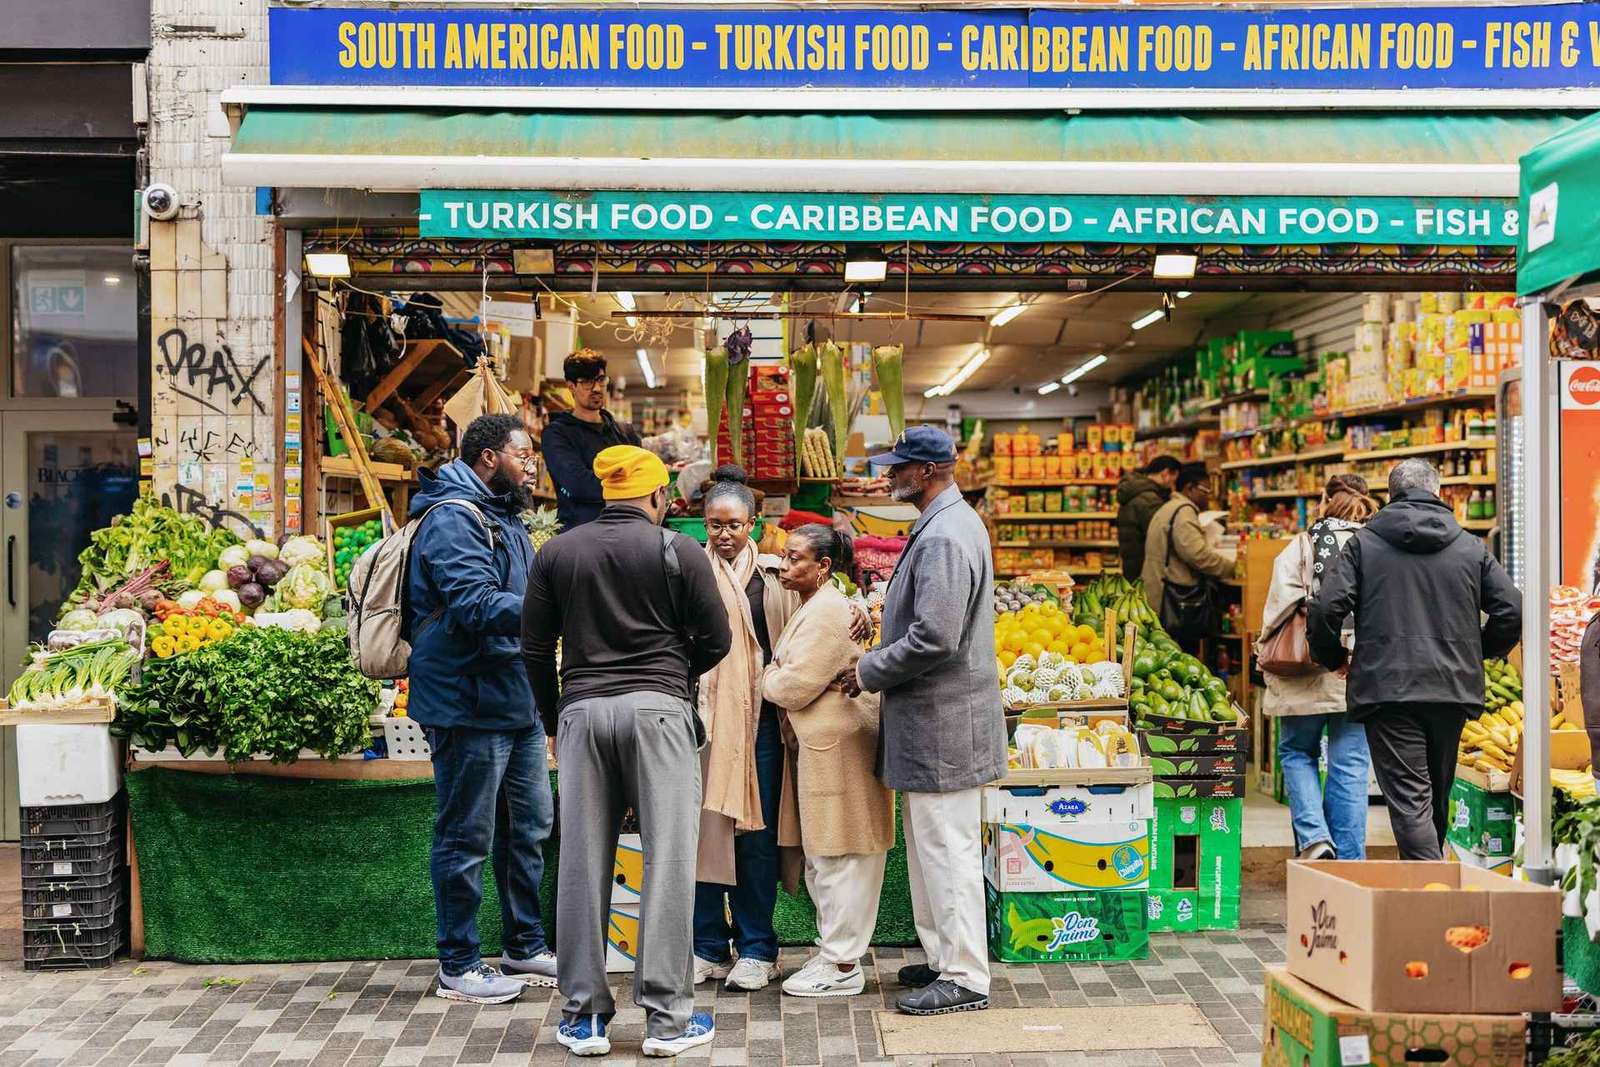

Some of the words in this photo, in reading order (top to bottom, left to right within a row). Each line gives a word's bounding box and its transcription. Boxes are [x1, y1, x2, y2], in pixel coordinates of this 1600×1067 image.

[338, 21, 436, 69] SOUTH
[443, 23, 600, 70] AMERICAN
[609, 23, 685, 70] FOOD
[691, 41, 707, 50] -
[714, 24, 846, 71] TURKISH
[854, 24, 930, 71] FOOD
[938, 42, 953, 50] -
[961, 24, 1129, 73] CARIBBEAN
[1138, 24, 1213, 72] FOOD
[1220, 42, 1236, 51] -
[1243, 23, 1371, 71] AFRICAN
[1379, 22, 1454, 70] FOOD
[1462, 39, 1477, 49] -
[1484, 21, 1552, 69] FISH
[1560, 20, 1581, 68] &
[443, 202, 598, 229] TURKISH
[611, 203, 713, 230] FOOD
[750, 204, 958, 232] CARIBBEAN
[971, 206, 1072, 233] FOOD
[1108, 207, 1266, 234] AFRICAN
[1279, 207, 1379, 234] FOOD
[1416, 208, 1490, 236] FISH
[1502, 209, 1519, 236] &
[157, 328, 270, 415] DRAX
[1064, 912, 1097, 930] Don
[1317, 899, 1336, 930] Don
[1047, 929, 1099, 950] Jaime
[1307, 926, 1338, 957] Jaime
